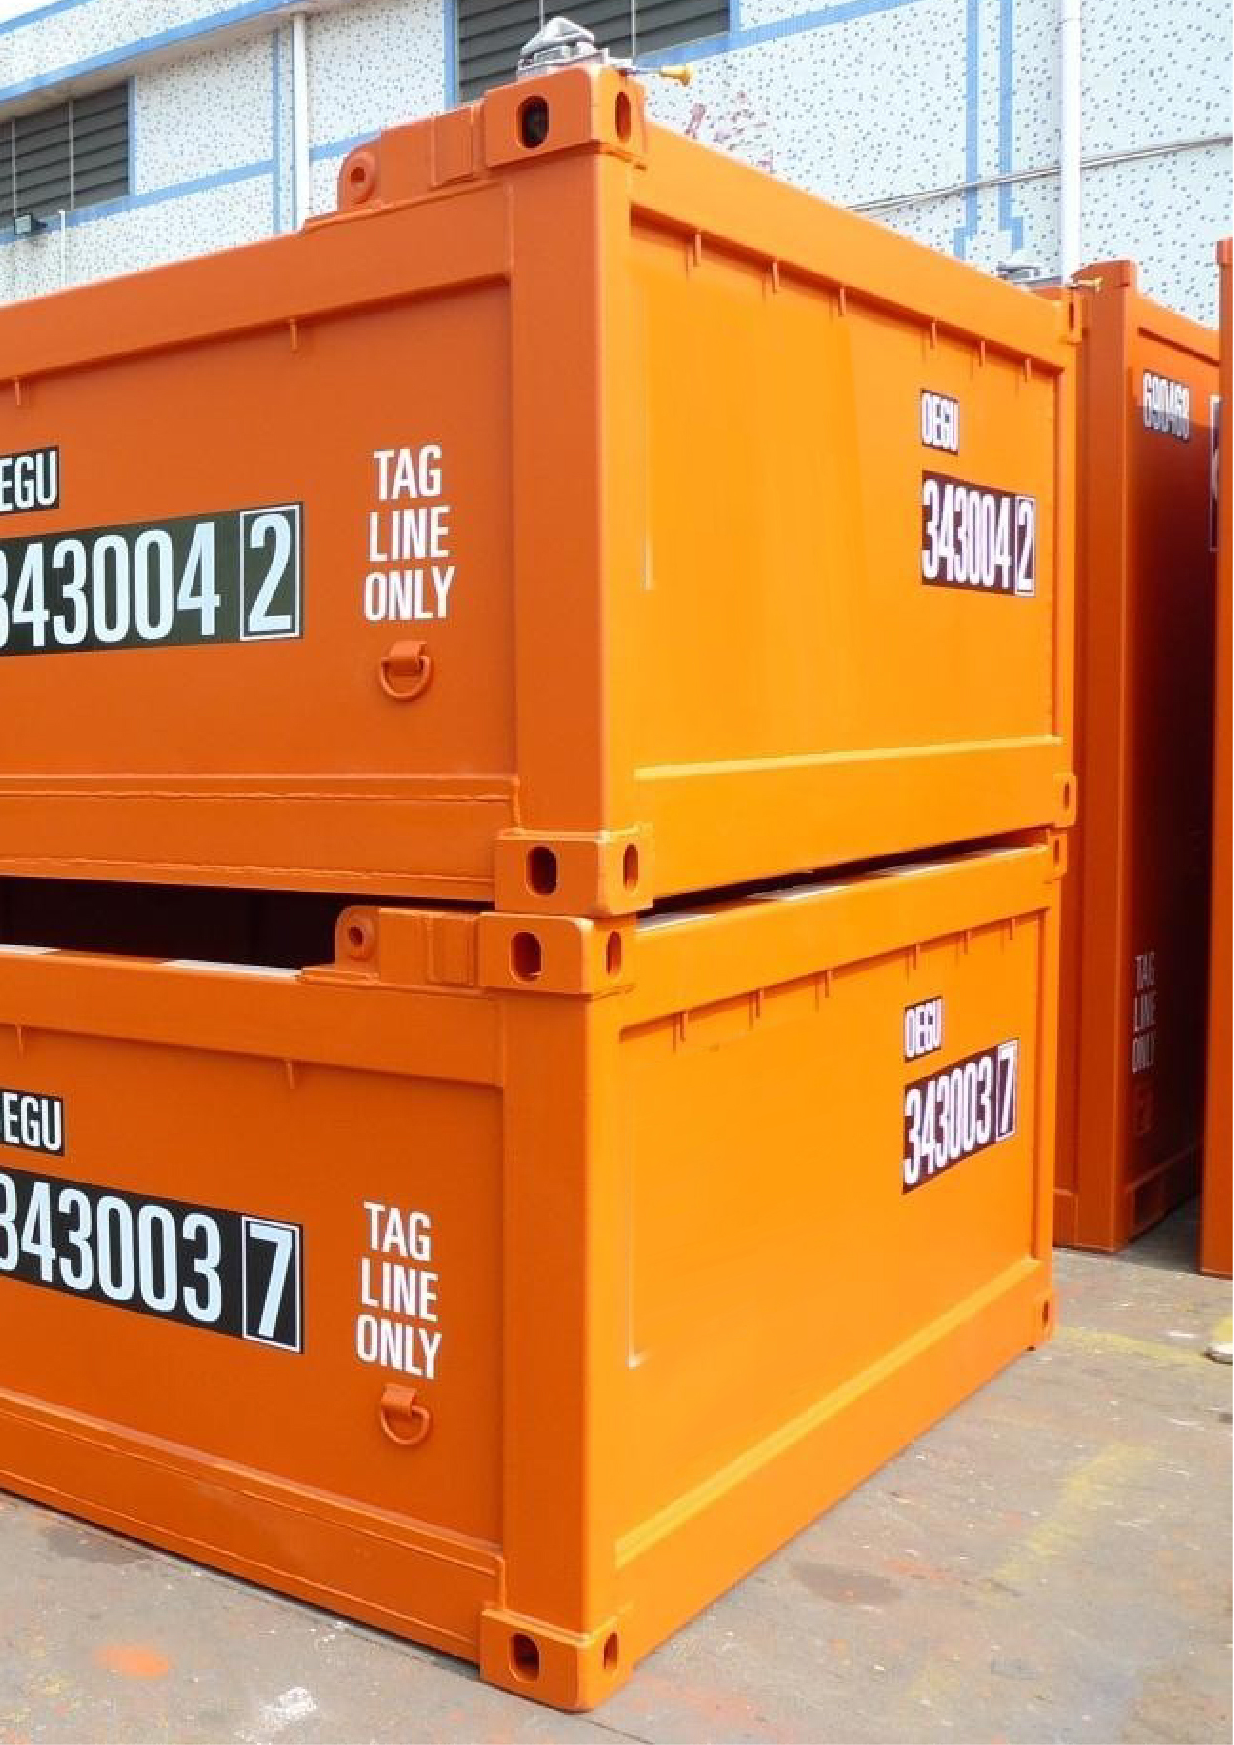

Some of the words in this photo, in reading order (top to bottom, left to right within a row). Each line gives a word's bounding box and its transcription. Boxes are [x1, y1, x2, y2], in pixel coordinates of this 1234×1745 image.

[922, 392, 959, 451] OEGU
[374, 445, 442, 501] TAG
[369, 506, 451, 563] LINE
[364, 566, 456, 621] ONLY
[905, 997, 942, 1059] OEGU
[364, 1201, 432, 1262] TAG
[361, 1257, 439, 1323] LINE
[356, 1314, 443, 1380] ONLY
